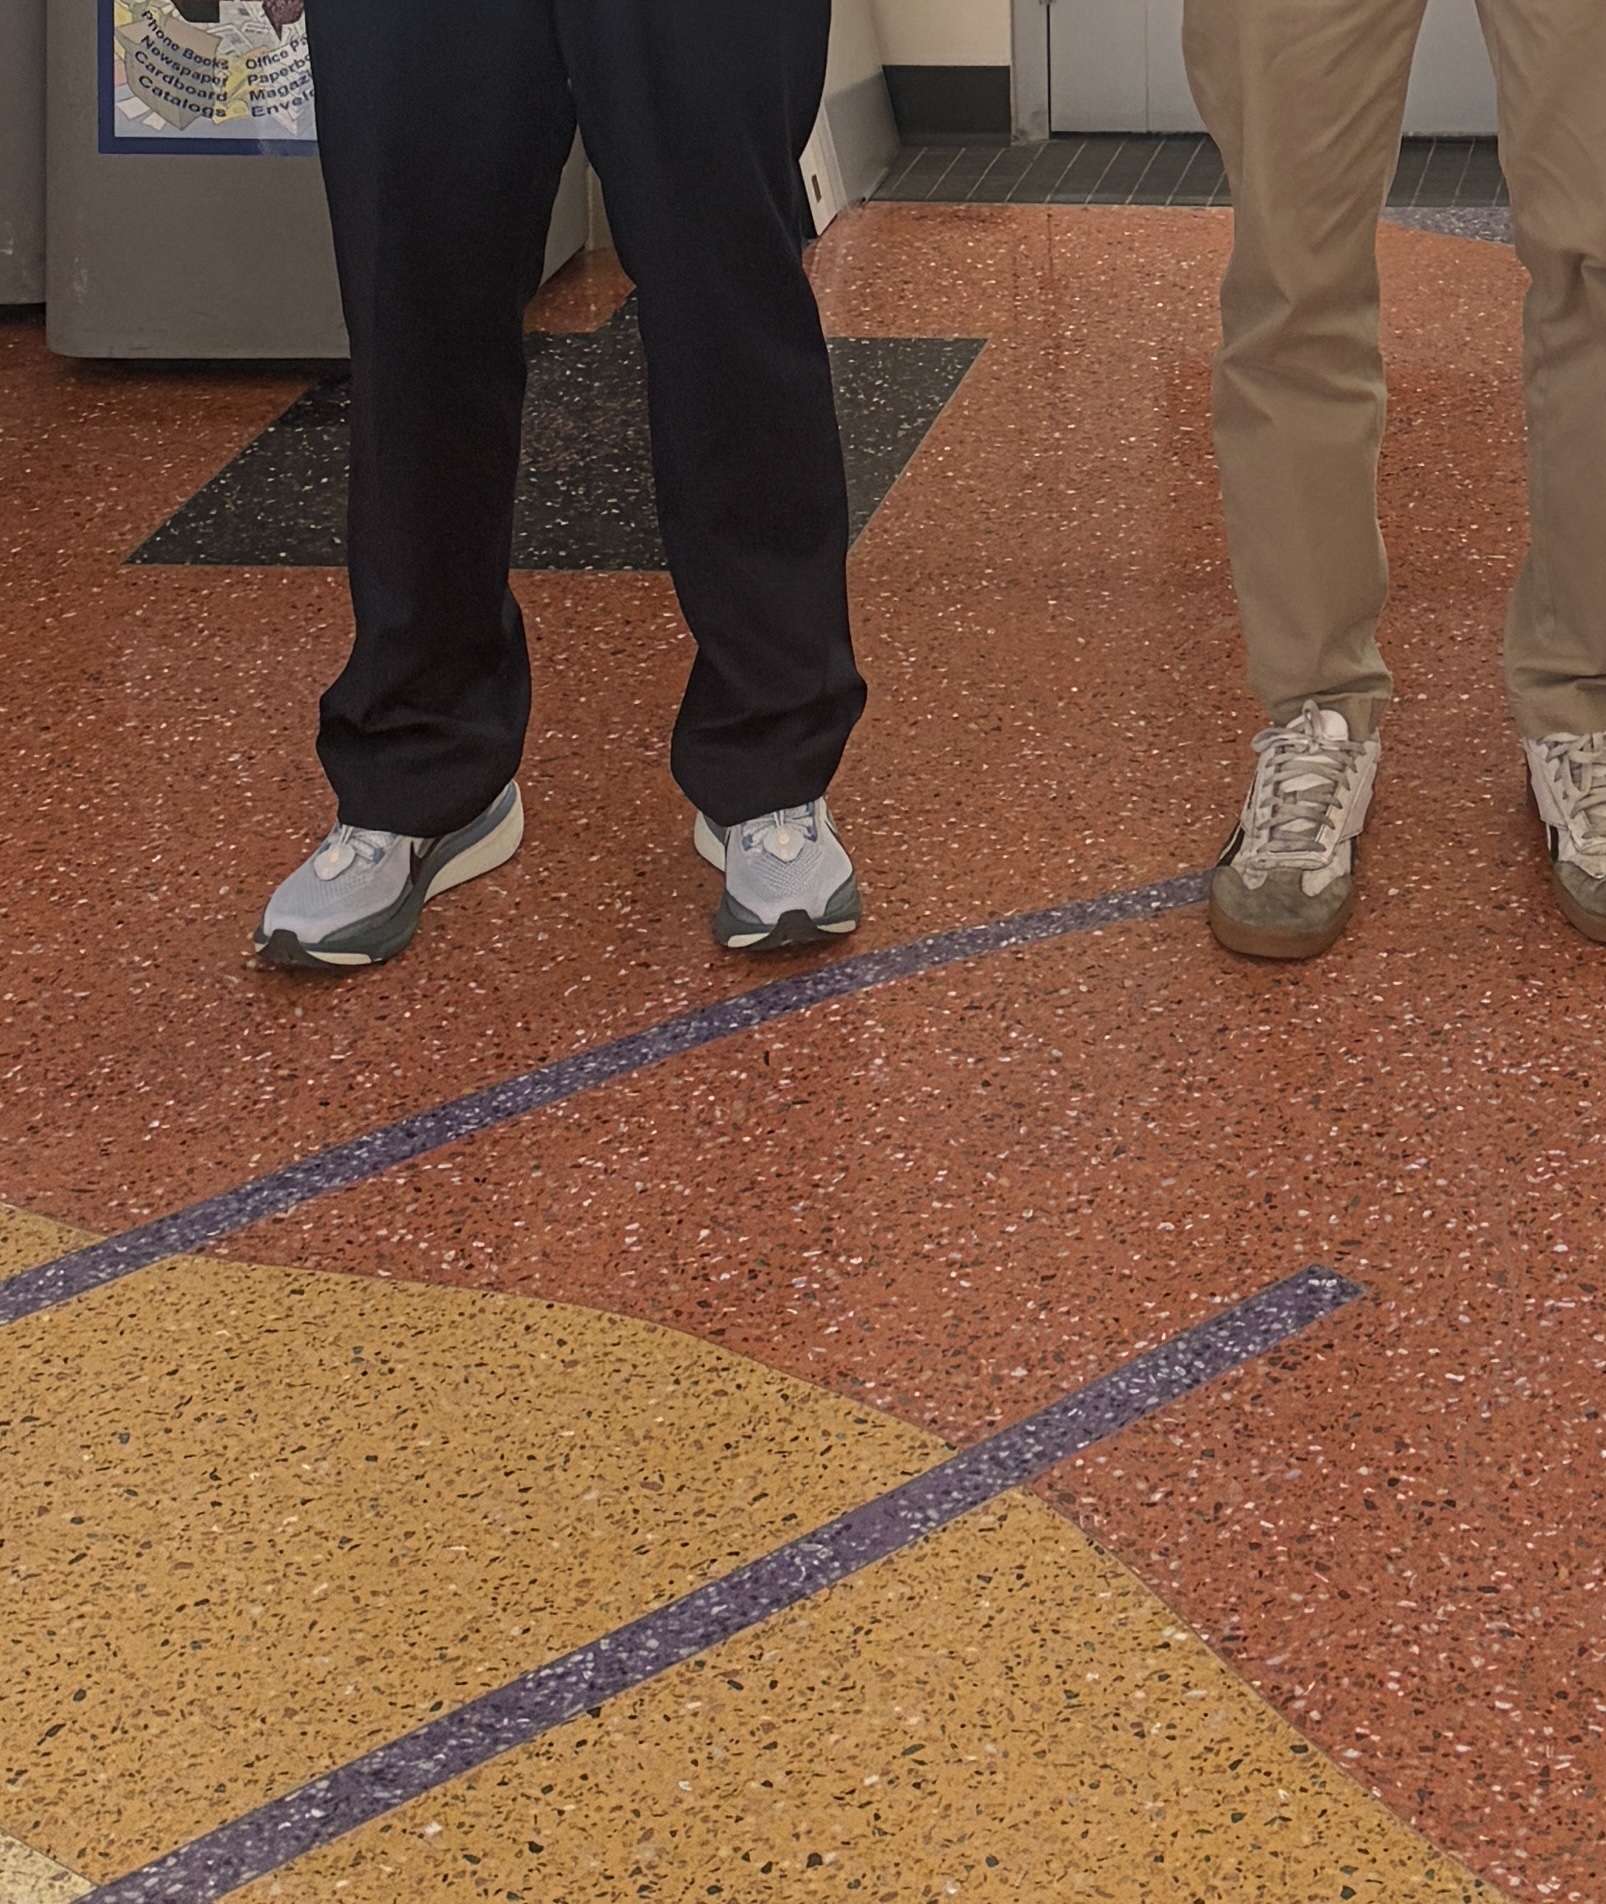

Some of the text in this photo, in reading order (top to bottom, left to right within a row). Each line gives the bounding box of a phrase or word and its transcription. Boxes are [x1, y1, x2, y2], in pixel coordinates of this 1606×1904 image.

[141, 10, 229, 70] Phone Books
[141, 35, 229, 87] Newspaper
[245, 50, 289, 69] Office
[135, 50, 228, 102] Cardboard
[138, 75, 227, 118] Catalogs
